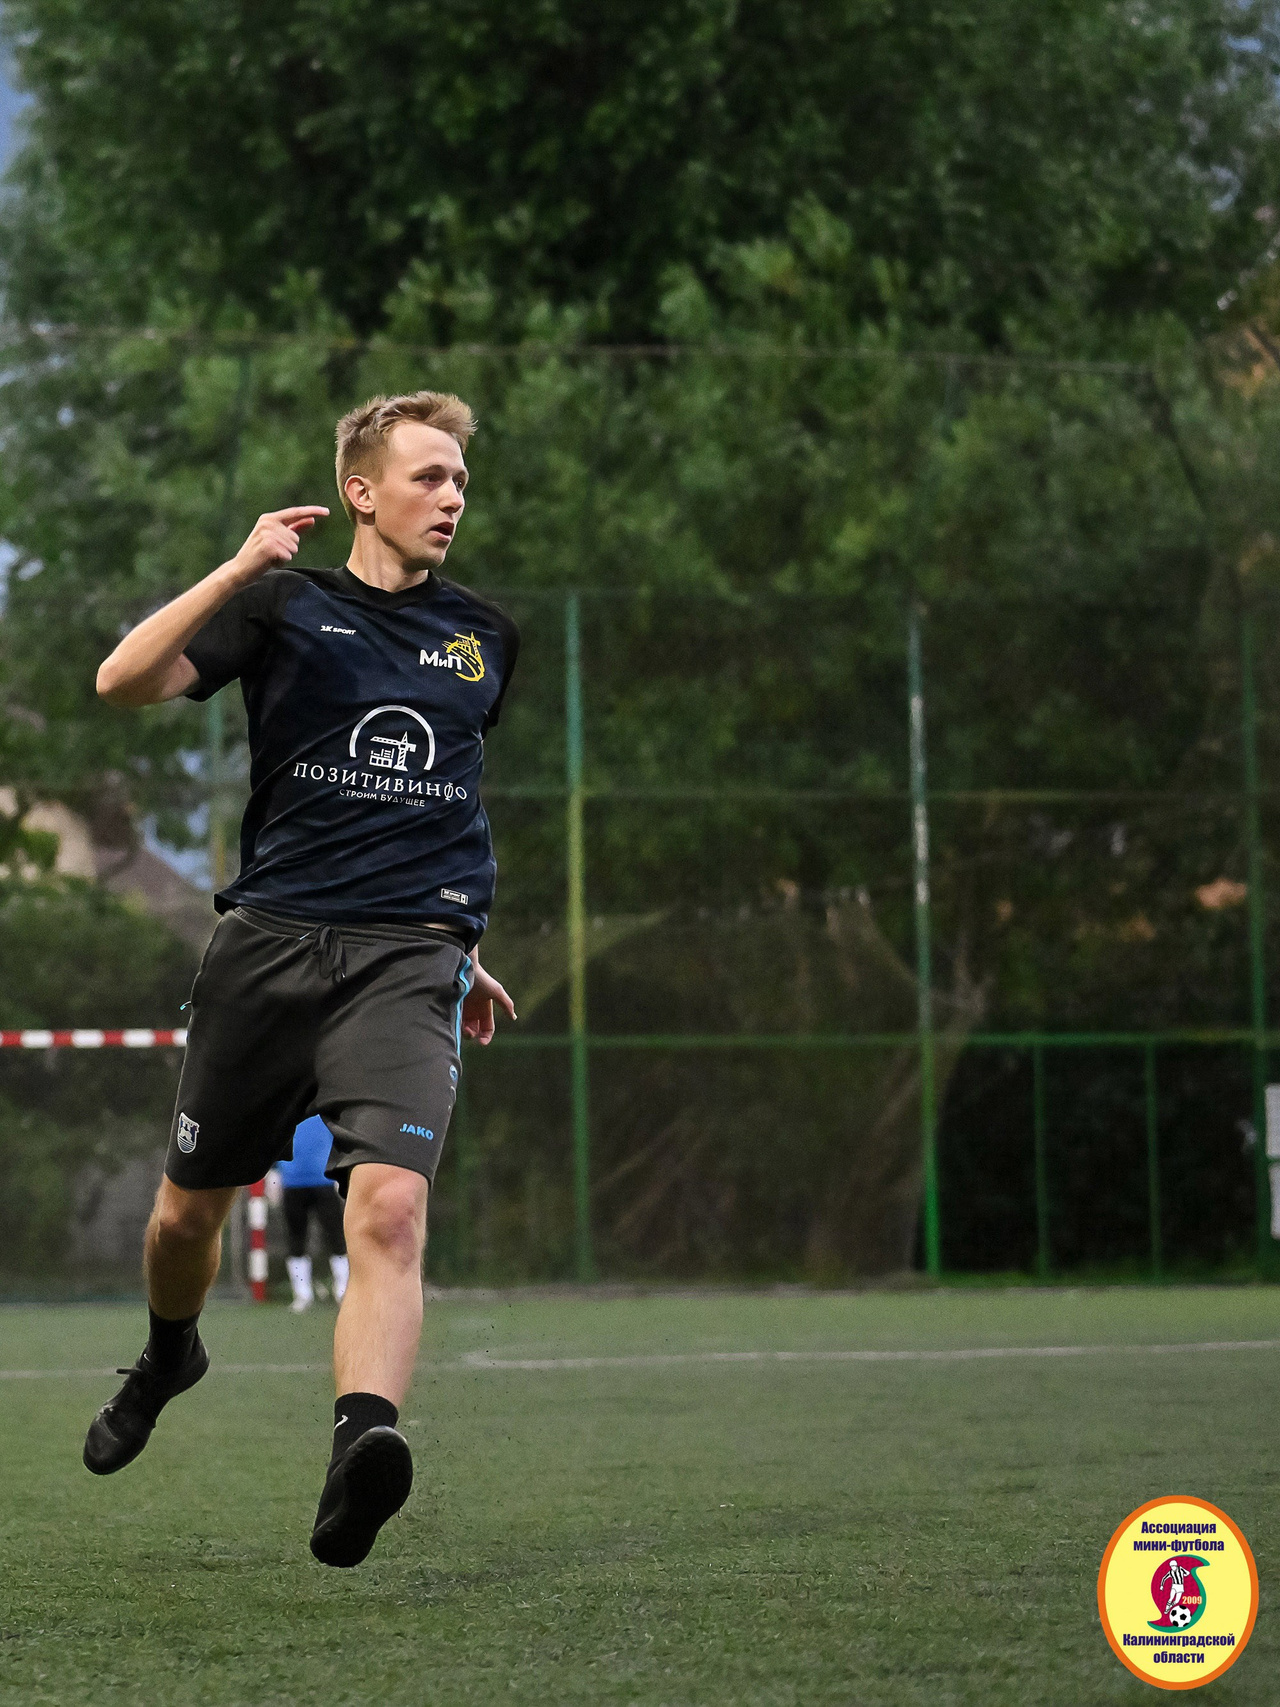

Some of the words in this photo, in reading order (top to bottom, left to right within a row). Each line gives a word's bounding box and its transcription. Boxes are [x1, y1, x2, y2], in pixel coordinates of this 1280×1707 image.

[333, 627, 356, 635] SPORT
[420, 649, 462, 670] МиП
[293, 762, 468, 801] ПОЗИТИВИНФО
[339, 788, 377, 801] СТРОИМ
[400, 1123, 434, 1141] JAKO
